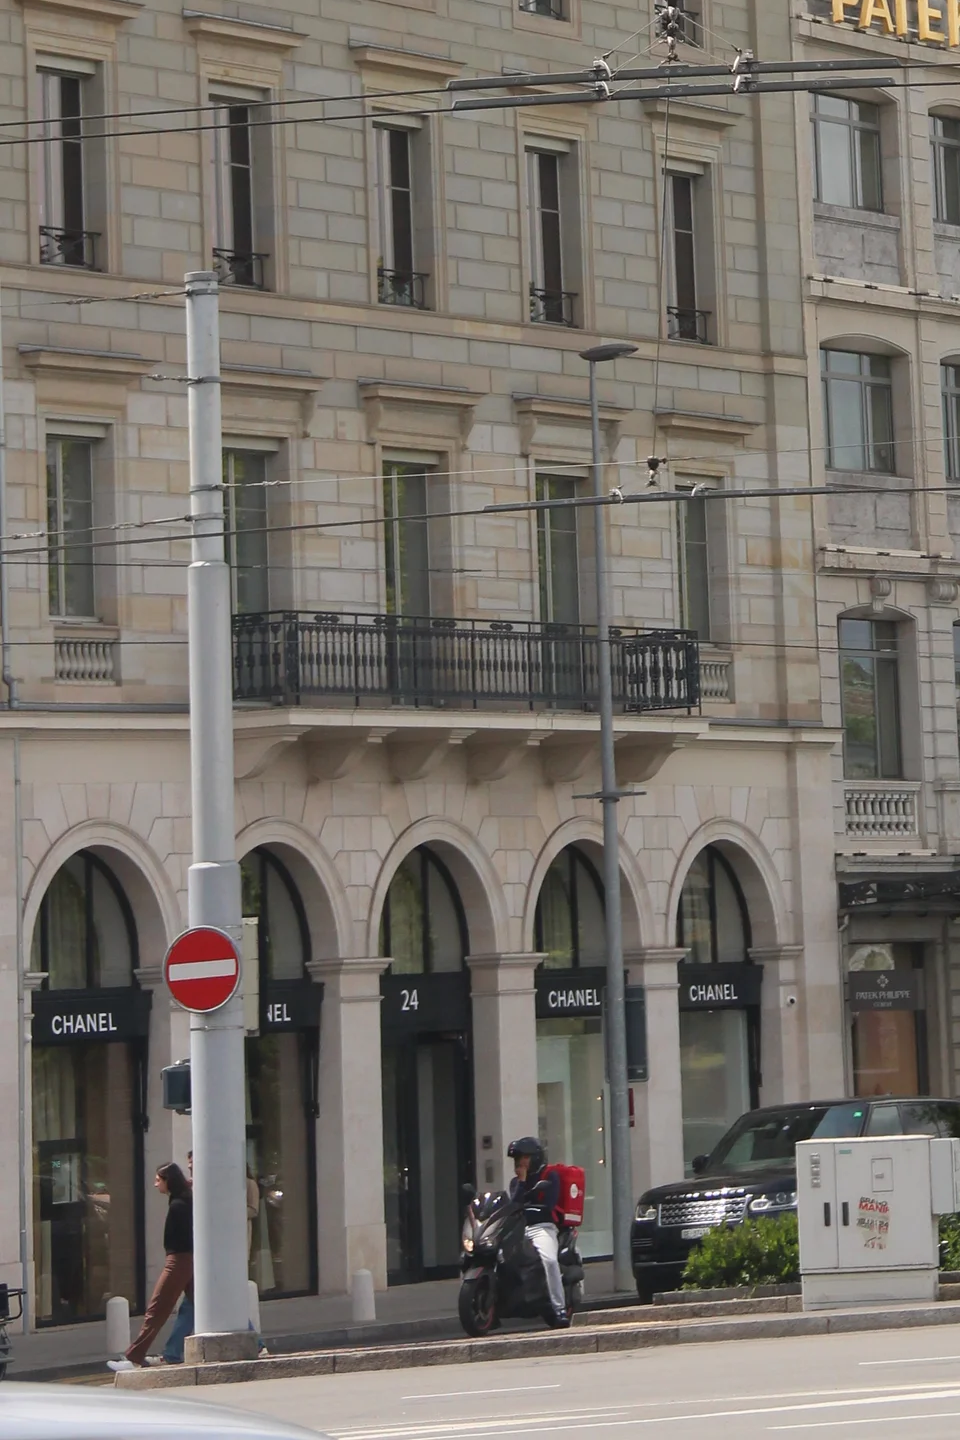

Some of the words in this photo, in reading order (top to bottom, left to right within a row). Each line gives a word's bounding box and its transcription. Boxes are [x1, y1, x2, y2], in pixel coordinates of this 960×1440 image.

[400, 989, 420, 1010] 24
[548, 988, 602, 1008] CHANEL
[689, 983, 738, 1002] CHANEL
[51, 1013, 118, 1035] CHANEL
